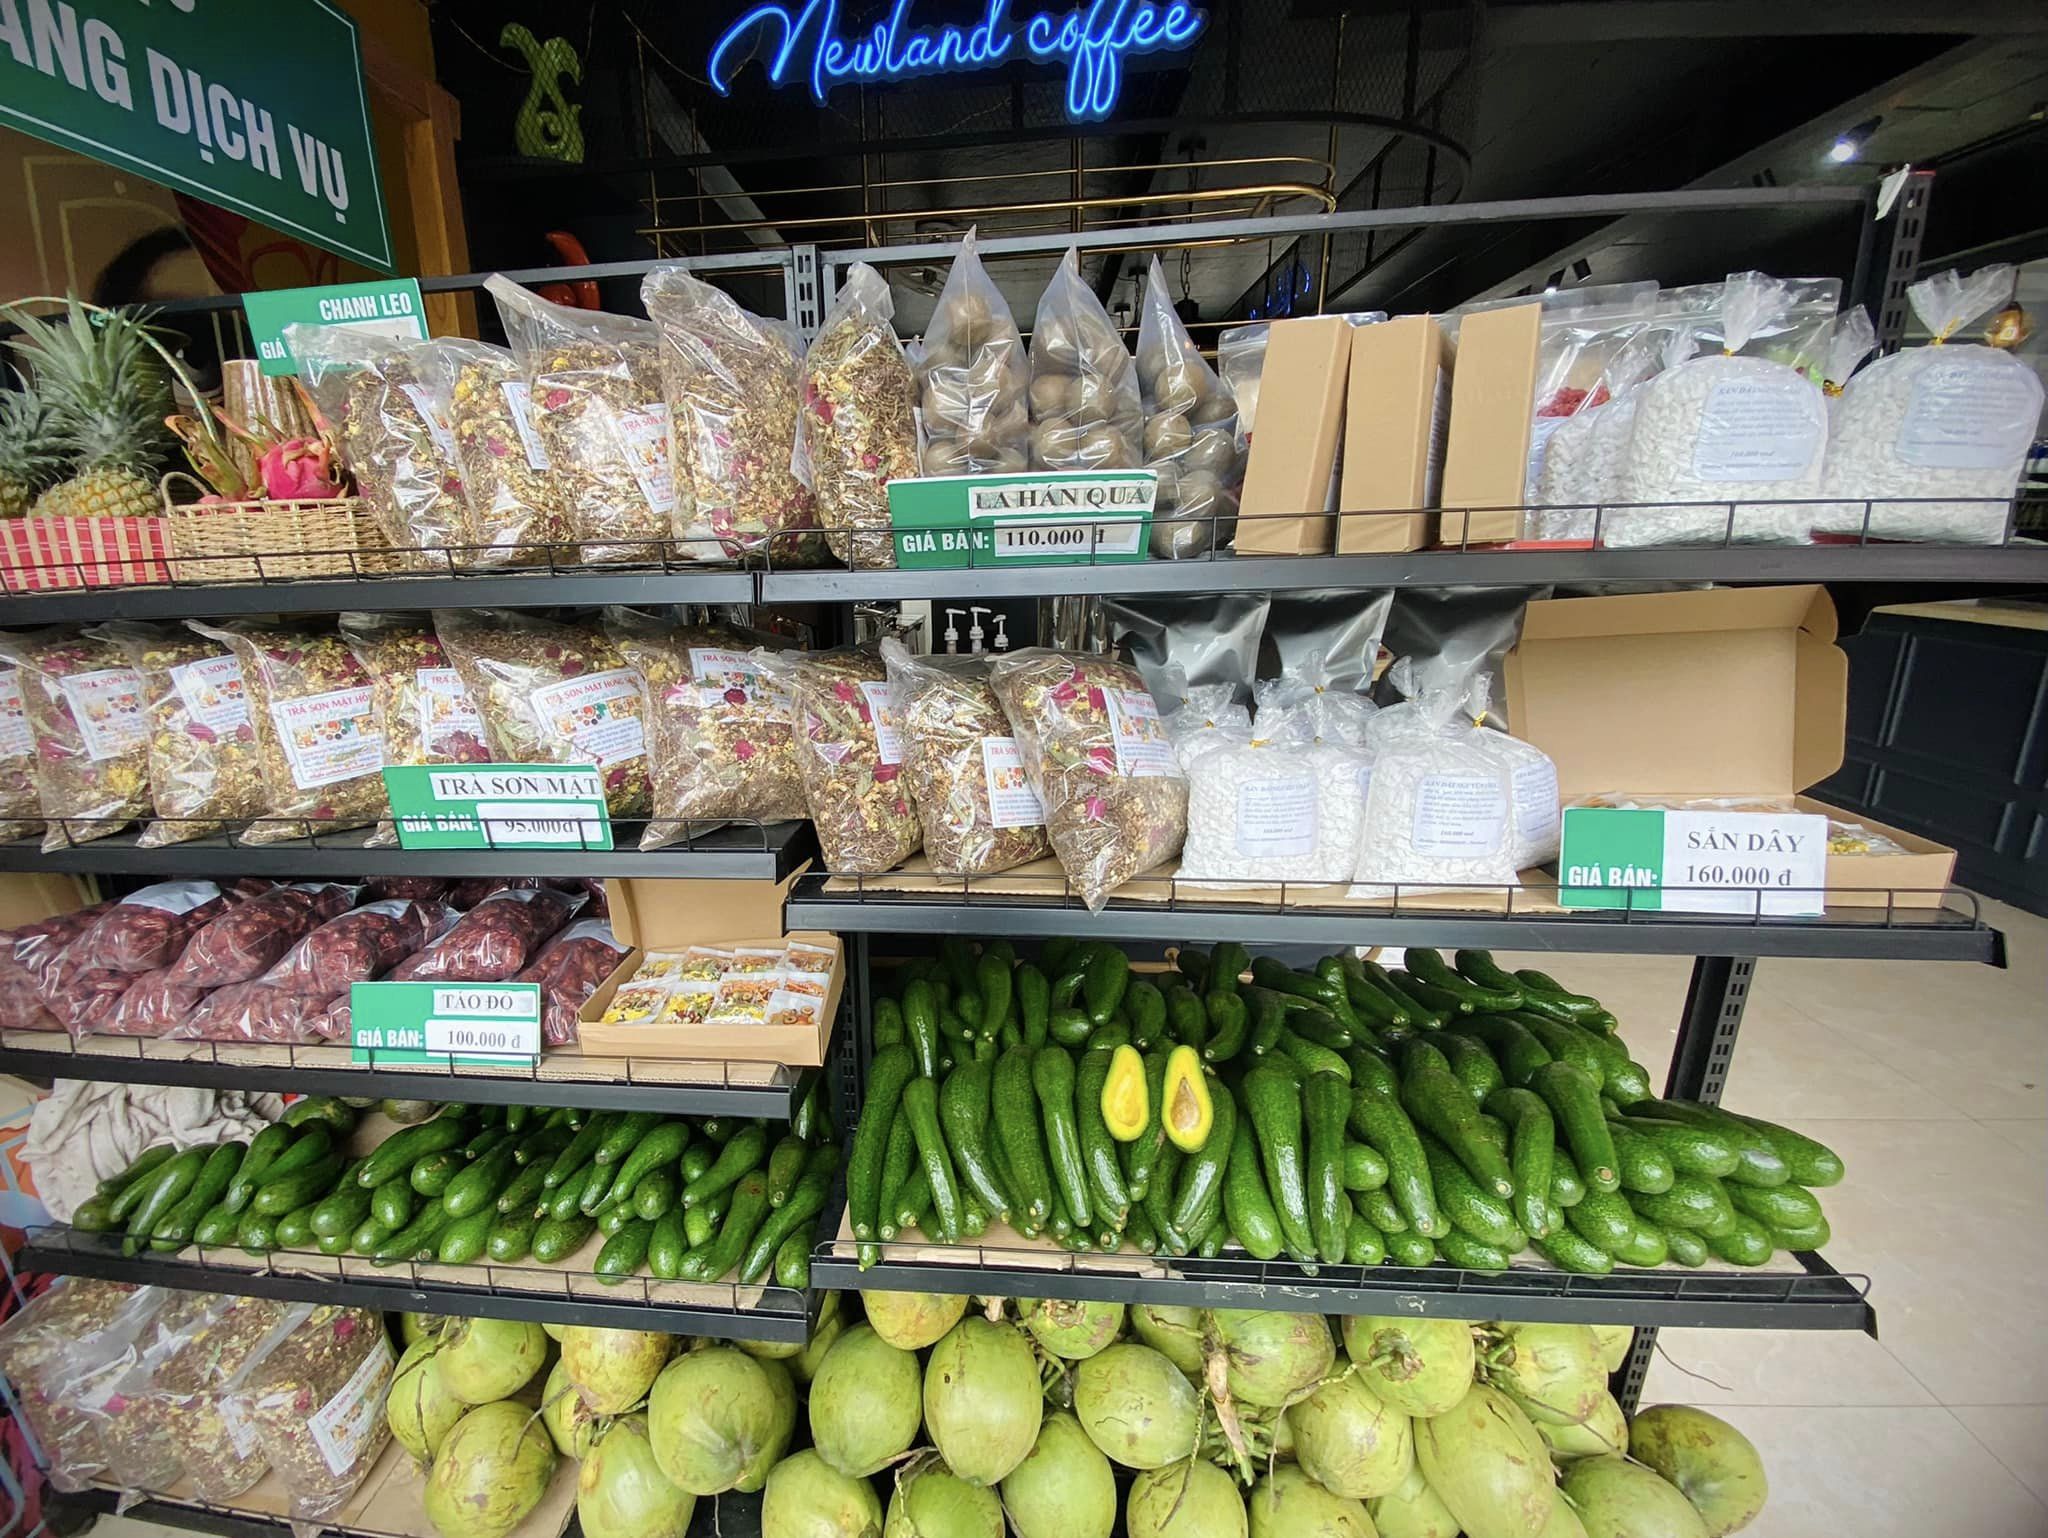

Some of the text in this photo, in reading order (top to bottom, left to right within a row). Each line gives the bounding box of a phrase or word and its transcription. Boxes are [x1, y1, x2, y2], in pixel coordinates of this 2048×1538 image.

[709, 0, 1202, 115] Newland coffee
[147, 47, 282, 180] DỊCH
[288, 123, 349, 225] VỤ
[319, 292, 413, 321] CHANH LEO
[260, 337, 287, 360] GIÁ
[1017, 484, 1077, 507] HÁN
[902, 530, 937, 553] GIÁ
[942, 529, 989, 551] BÁN:
[1006, 528, 1084, 546] 110.000
[439, 773, 486, 795] TRÀ
[491, 775, 540, 795] SƠN
[402, 811, 433, 832] GIÁ
[1746, 829, 1806, 853] DÂY
[1568, 862, 1601, 887] GIÁ
[1608, 863, 1658, 887] BÁN:
[1687, 864, 1770, 886] 160.000
[442, 991, 481, 1010] TÁO
[357, 1027, 383, 1047] GIÁ
[386, 1027, 424, 1048] BÁN:
[448, 1030, 506, 1049] 100.000
